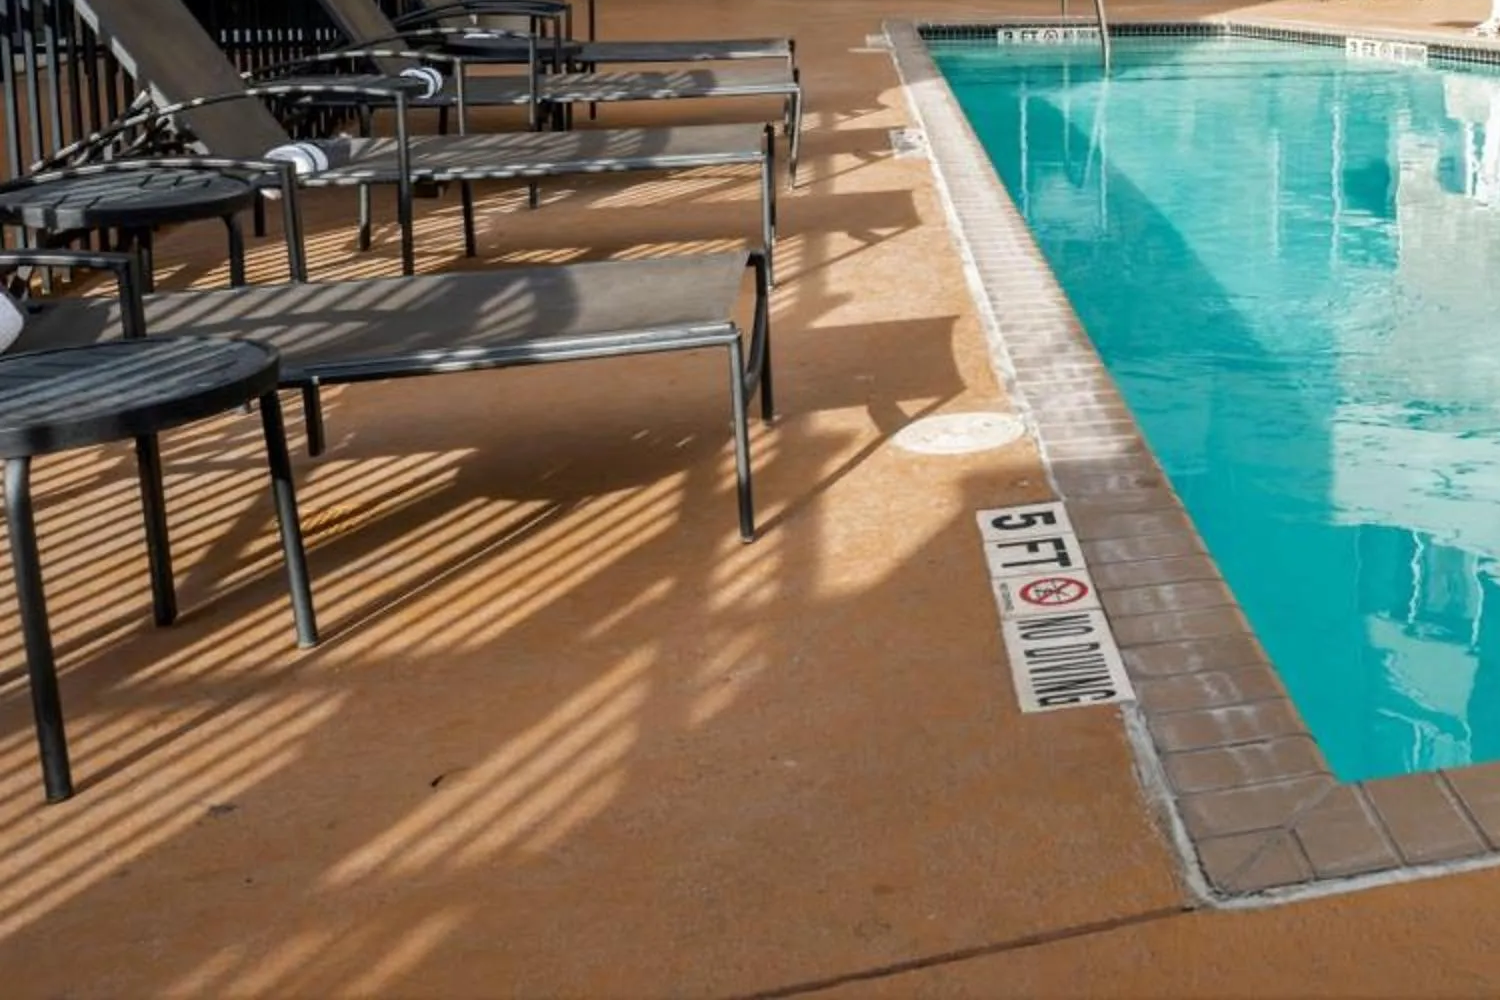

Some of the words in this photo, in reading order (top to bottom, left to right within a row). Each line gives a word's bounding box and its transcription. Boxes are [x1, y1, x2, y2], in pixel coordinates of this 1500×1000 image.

[991, 511, 1057, 530] 5
[997, 537, 1072, 568] FT
[1016, 614, 1095, 641] NO
[1024, 643, 1116, 707] DIVING
